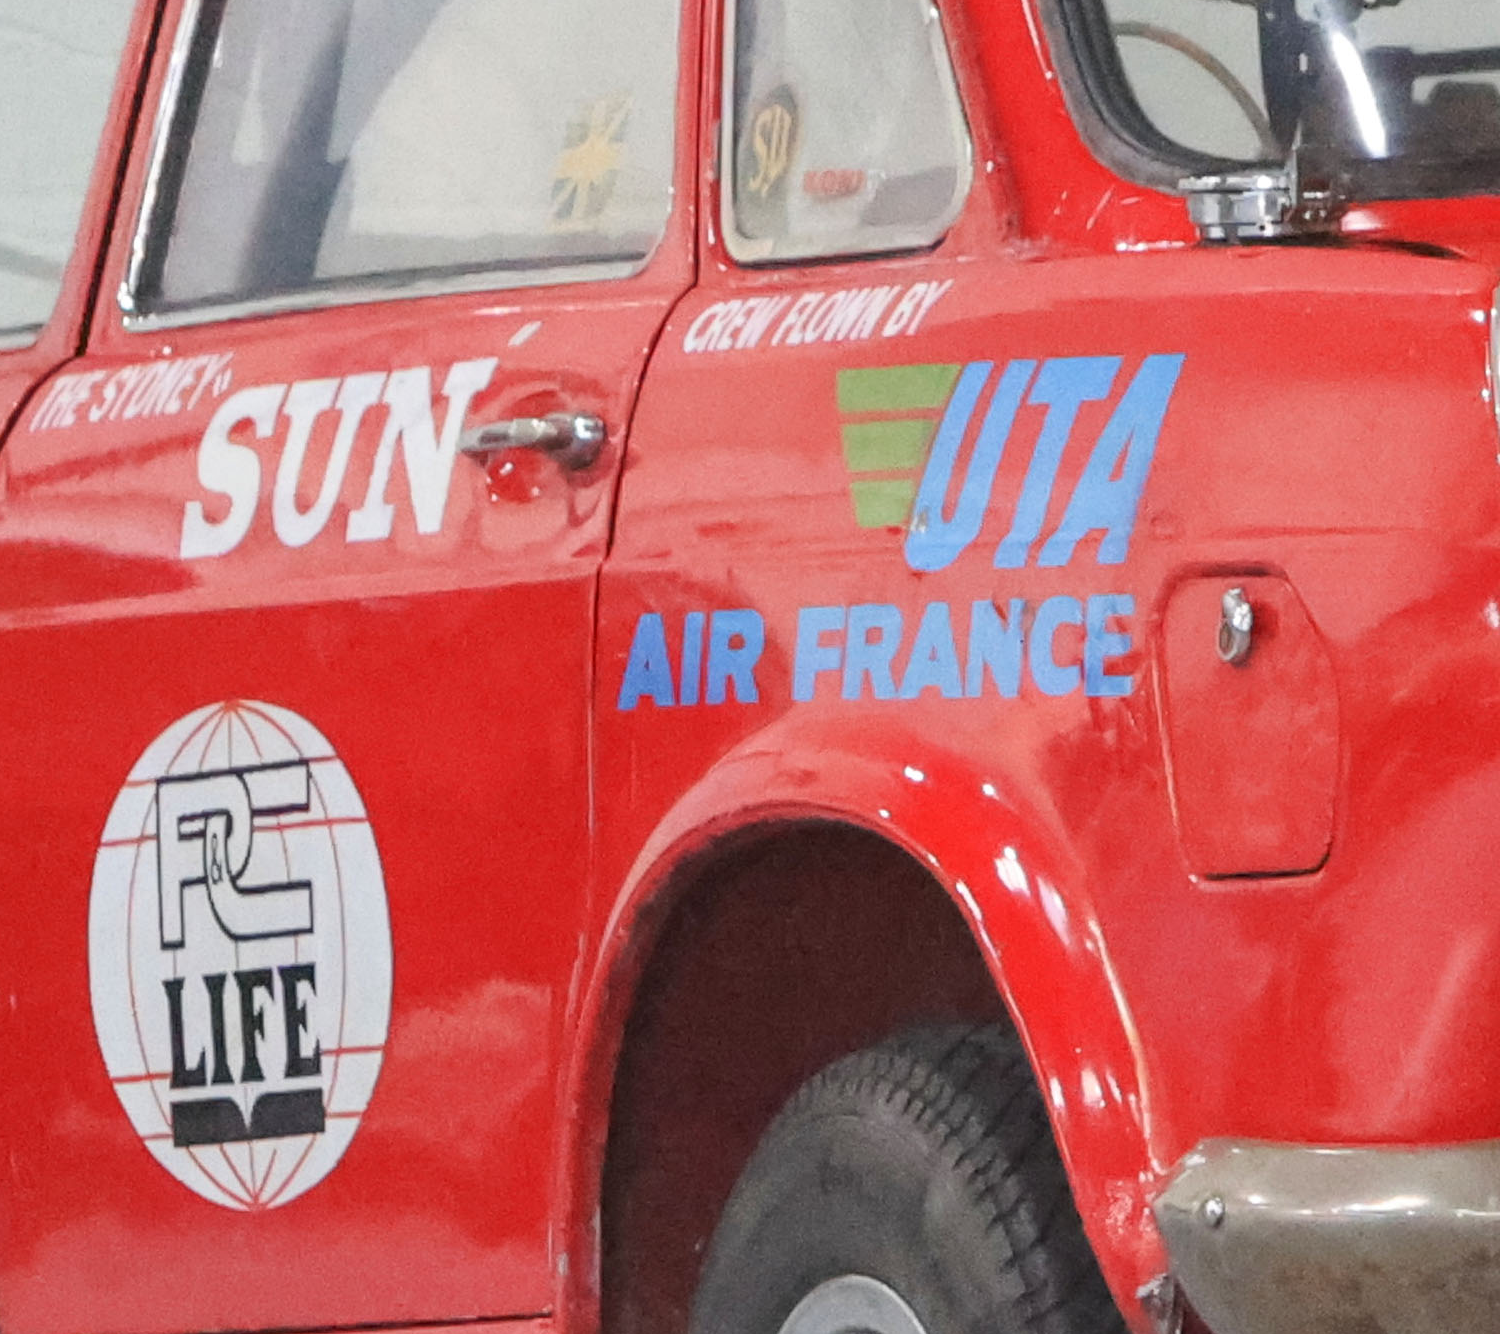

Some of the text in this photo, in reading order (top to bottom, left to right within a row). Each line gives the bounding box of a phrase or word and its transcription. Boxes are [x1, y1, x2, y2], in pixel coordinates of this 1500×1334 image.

[683, 278, 954, 354] CREW FLOWN BY
[30, 351, 235, 432] THE SYDNEY
[180, 357, 499, 559] SUN
[904, 352, 1187, 572] UTA
[617, 594, 1136, 711] AIR FRANCE
[162, 965, 323, 1089] LIFE
